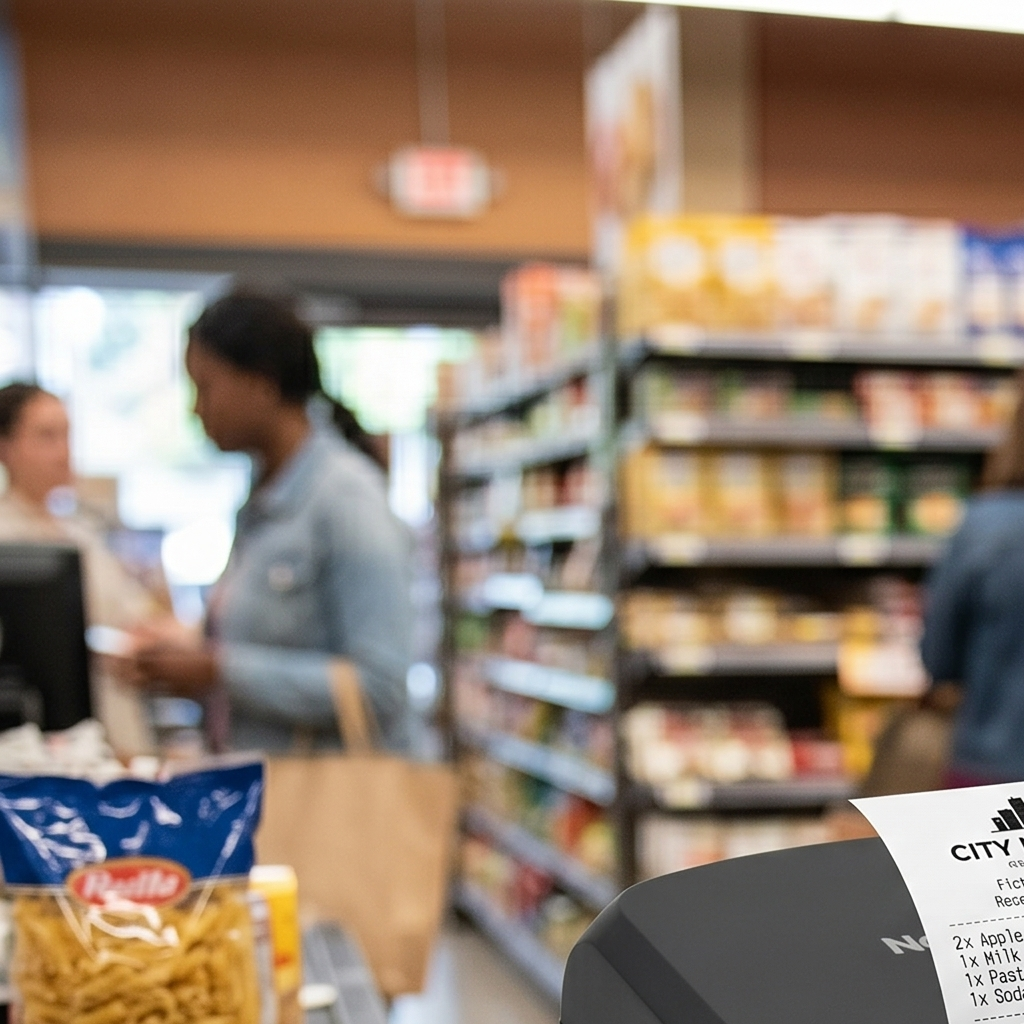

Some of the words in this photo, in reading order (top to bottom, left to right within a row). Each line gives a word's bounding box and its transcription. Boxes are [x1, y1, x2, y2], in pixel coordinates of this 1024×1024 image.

[950, 839, 1010, 862] CITY
[952, 935, 974, 950] 2x
[980, 928, 1024, 949] Apple
[960, 954, 980, 968] 1x
[983, 947, 1022, 966] Milk
[965, 972, 985, 988] 1x
[970, 991, 989, 1007] 1x
